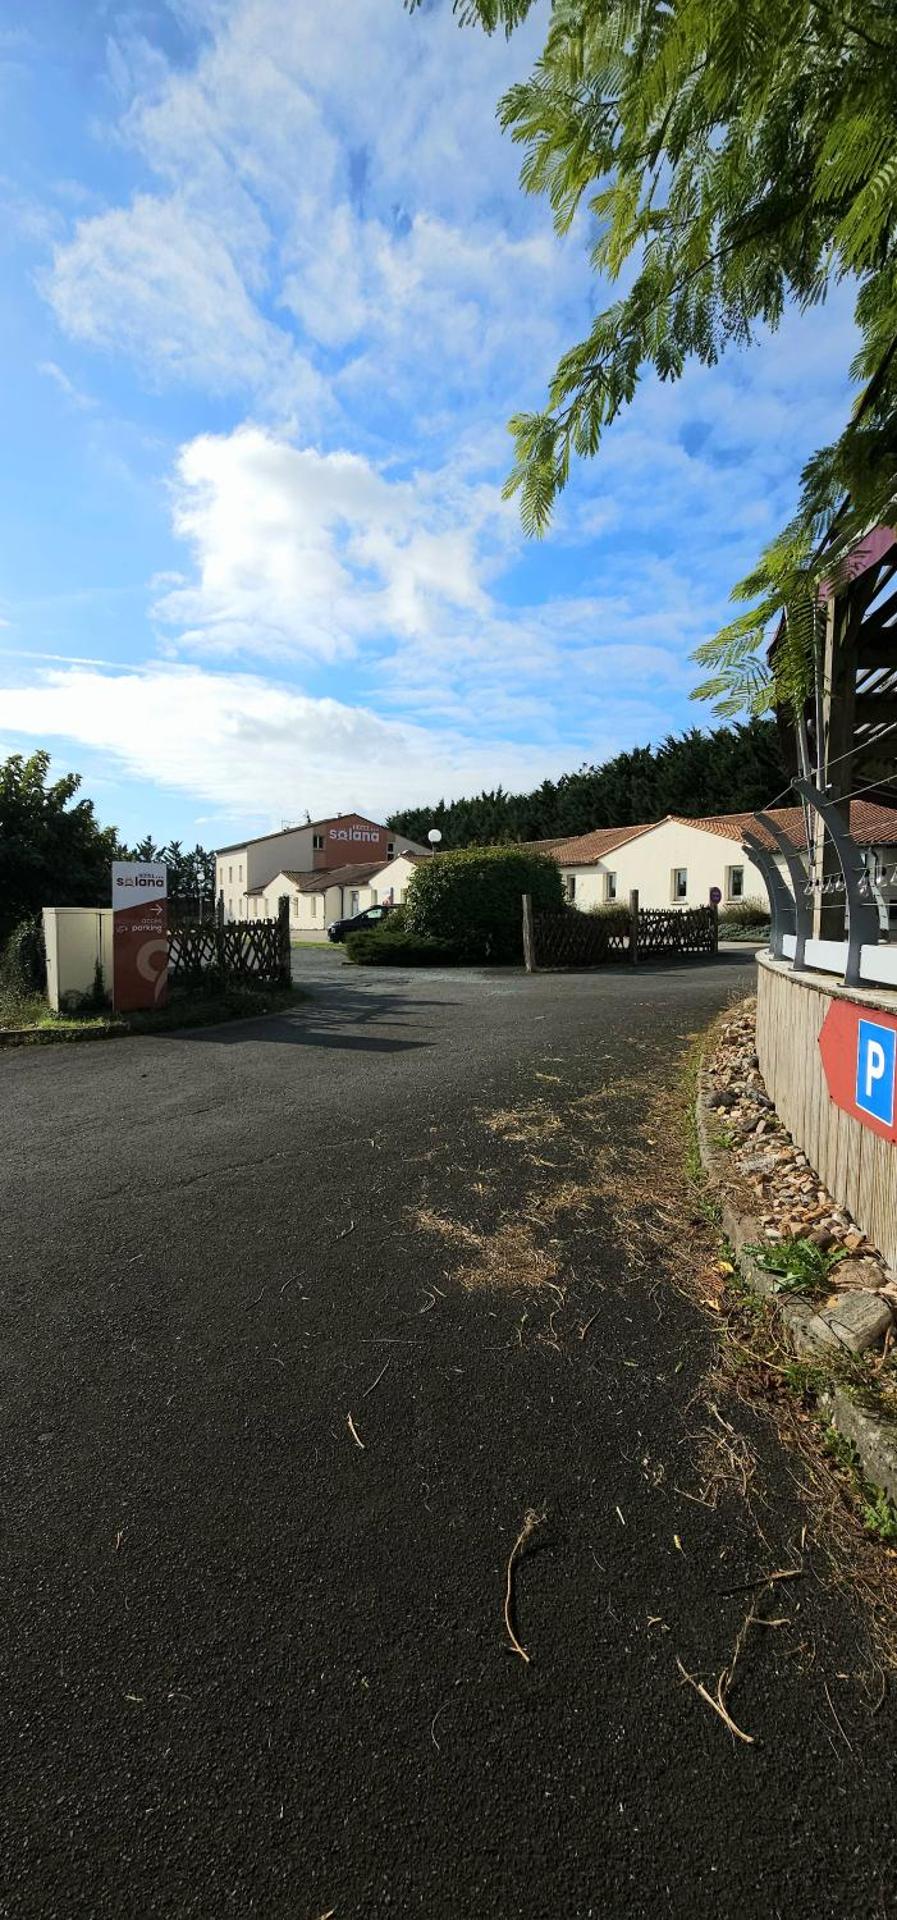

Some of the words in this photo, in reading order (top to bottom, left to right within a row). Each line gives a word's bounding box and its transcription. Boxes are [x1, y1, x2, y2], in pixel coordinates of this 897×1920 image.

[329, 828, 380, 842] solana
[116, 876, 164, 887] solana
[131, 924, 162, 933] parking
[865, 1039, 885, 1097] P
